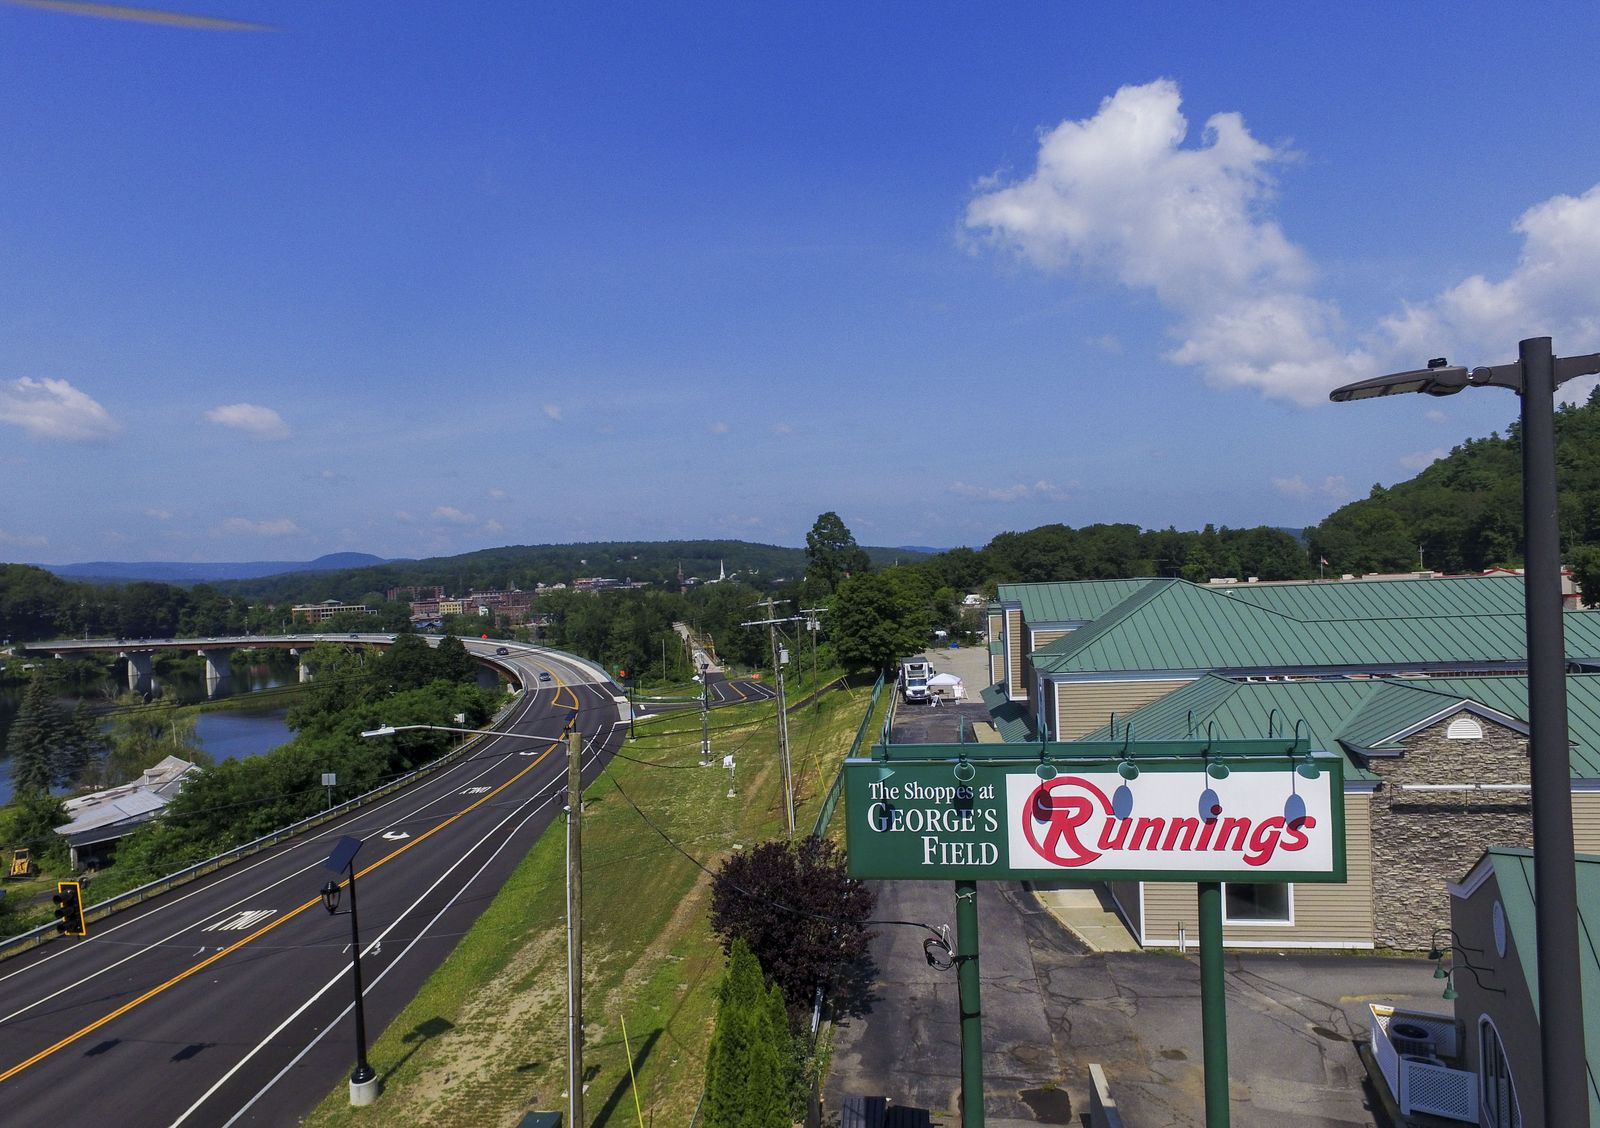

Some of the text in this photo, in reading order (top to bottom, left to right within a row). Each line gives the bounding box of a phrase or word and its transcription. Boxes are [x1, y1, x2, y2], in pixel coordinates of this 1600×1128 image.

[868, 781, 995, 804] The Shoppes at
[867, 802, 998, 832] GEORGE'S
[1022, 776, 1317, 867] Runnings
[920, 836, 999, 865] FIELD
[201, 909, 278, 932] ONLY
